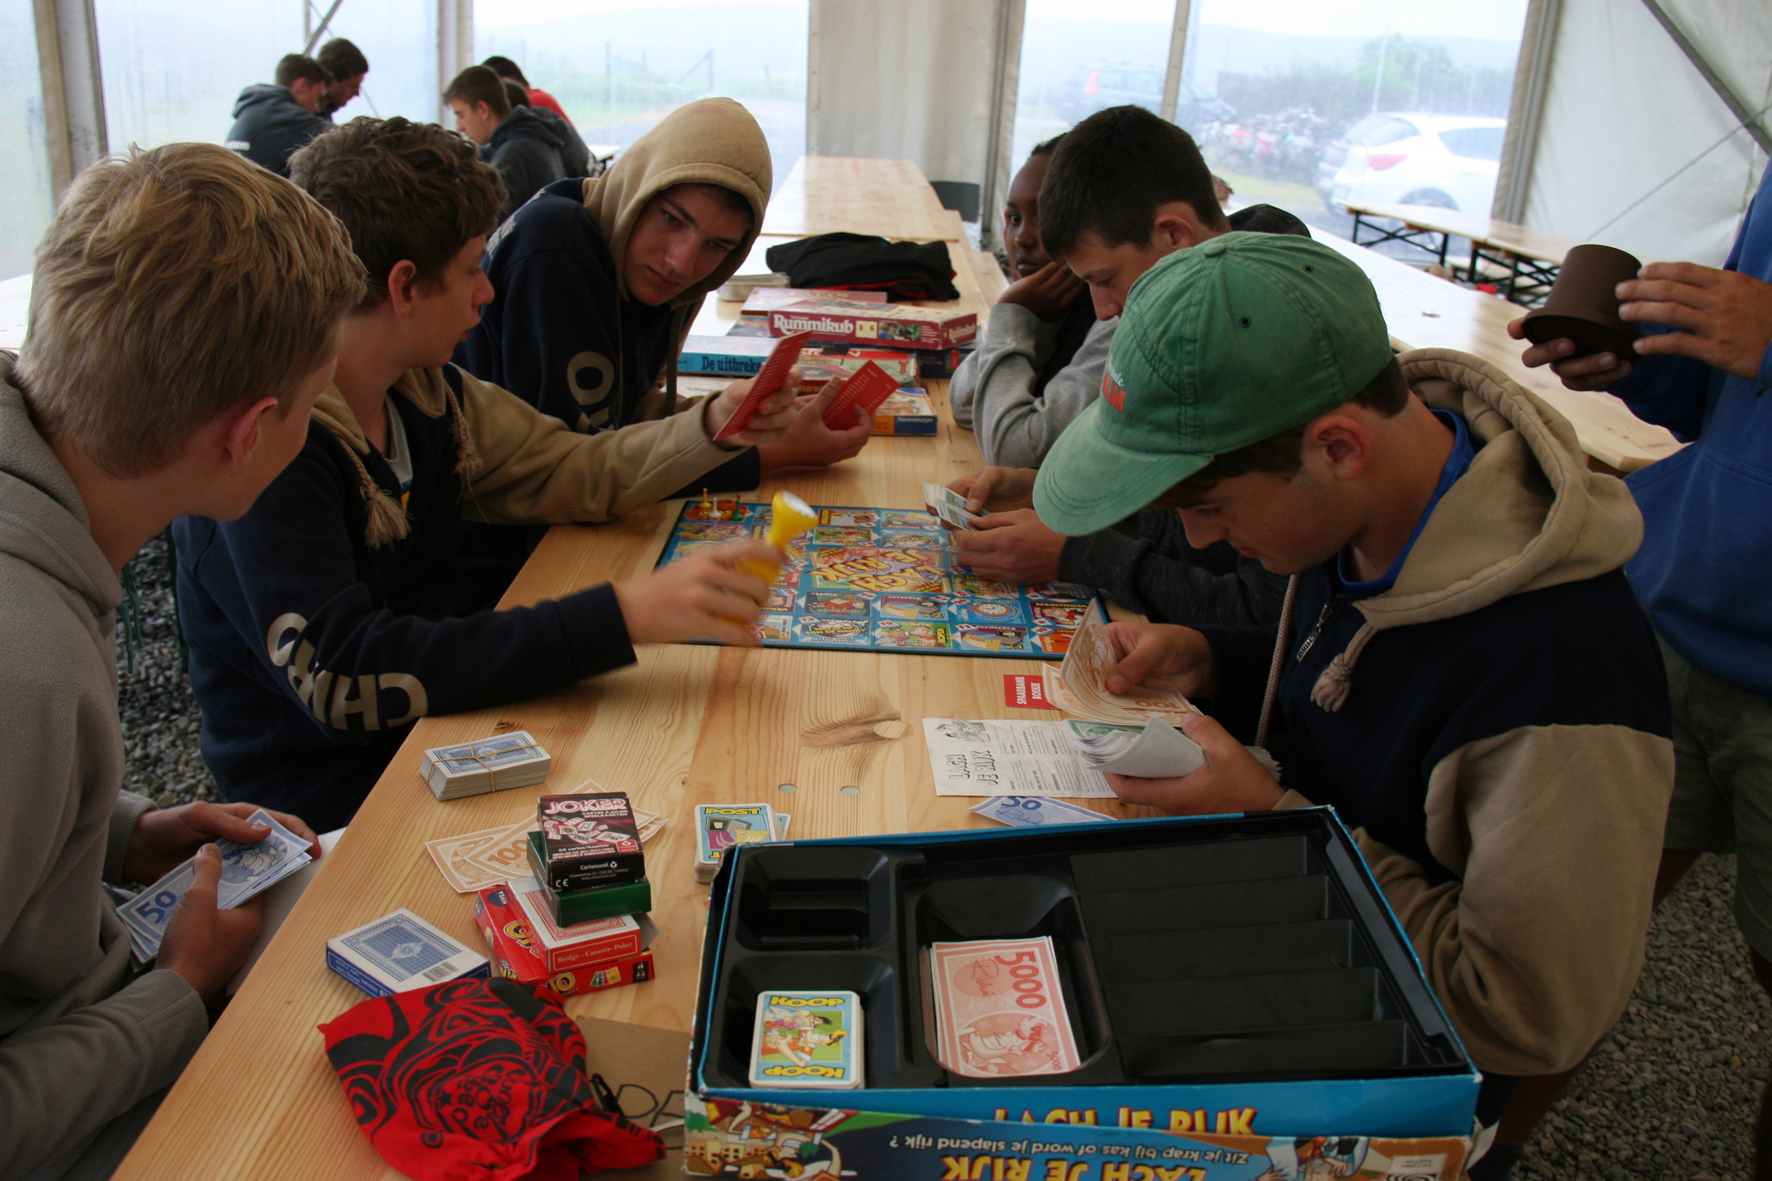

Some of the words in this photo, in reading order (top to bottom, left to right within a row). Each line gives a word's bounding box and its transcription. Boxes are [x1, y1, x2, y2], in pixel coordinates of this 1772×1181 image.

[773, 314, 854, 335] Rummikub
[701, 356, 716, 370] De
[850, 565, 945, 592] LACH
[1015, 676, 1027, 705] SPAARBANK
[945, 753, 970, 780] LACH
[971, 750, 998, 773] RIJK
[976, 772, 999, 787] JE
[544, 799, 628, 815] JOKER
[705, 807, 762, 816] POST
[487, 839, 528, 867] 100
[580, 862, 609, 871] Cartamundi
[555, 878, 570, 889] CE
[136, 890, 177, 925] 50
[557, 954, 580, 964] Bridge
[614, 941, 633, 951] Poker
[994, 951, 1047, 1009] 5000
[769, 995, 846, 1008] KOOP
[1045, 1051, 1063, 1071] 5000
[763, 1065, 847, 1079] KOOP
[905, 1135, 933, 1150] rijk
[937, 1137, 1006, 1154] slapend
[1011, 1140, 1029, 1155] je
[1032, 1142, 1074, 1155] word
[1077, 1144, 1097, 1156] of
[1103, 1144, 1131, 1157] kas
[1134, 1144, 1157, 1159] bij
[1163, 1146, 1200, 1161] krap
[1204, 1148, 1222, 1163] je
[1226, 1150, 1249, 1164] Zit
[939, 1155, 1034, 1181] RIJK
